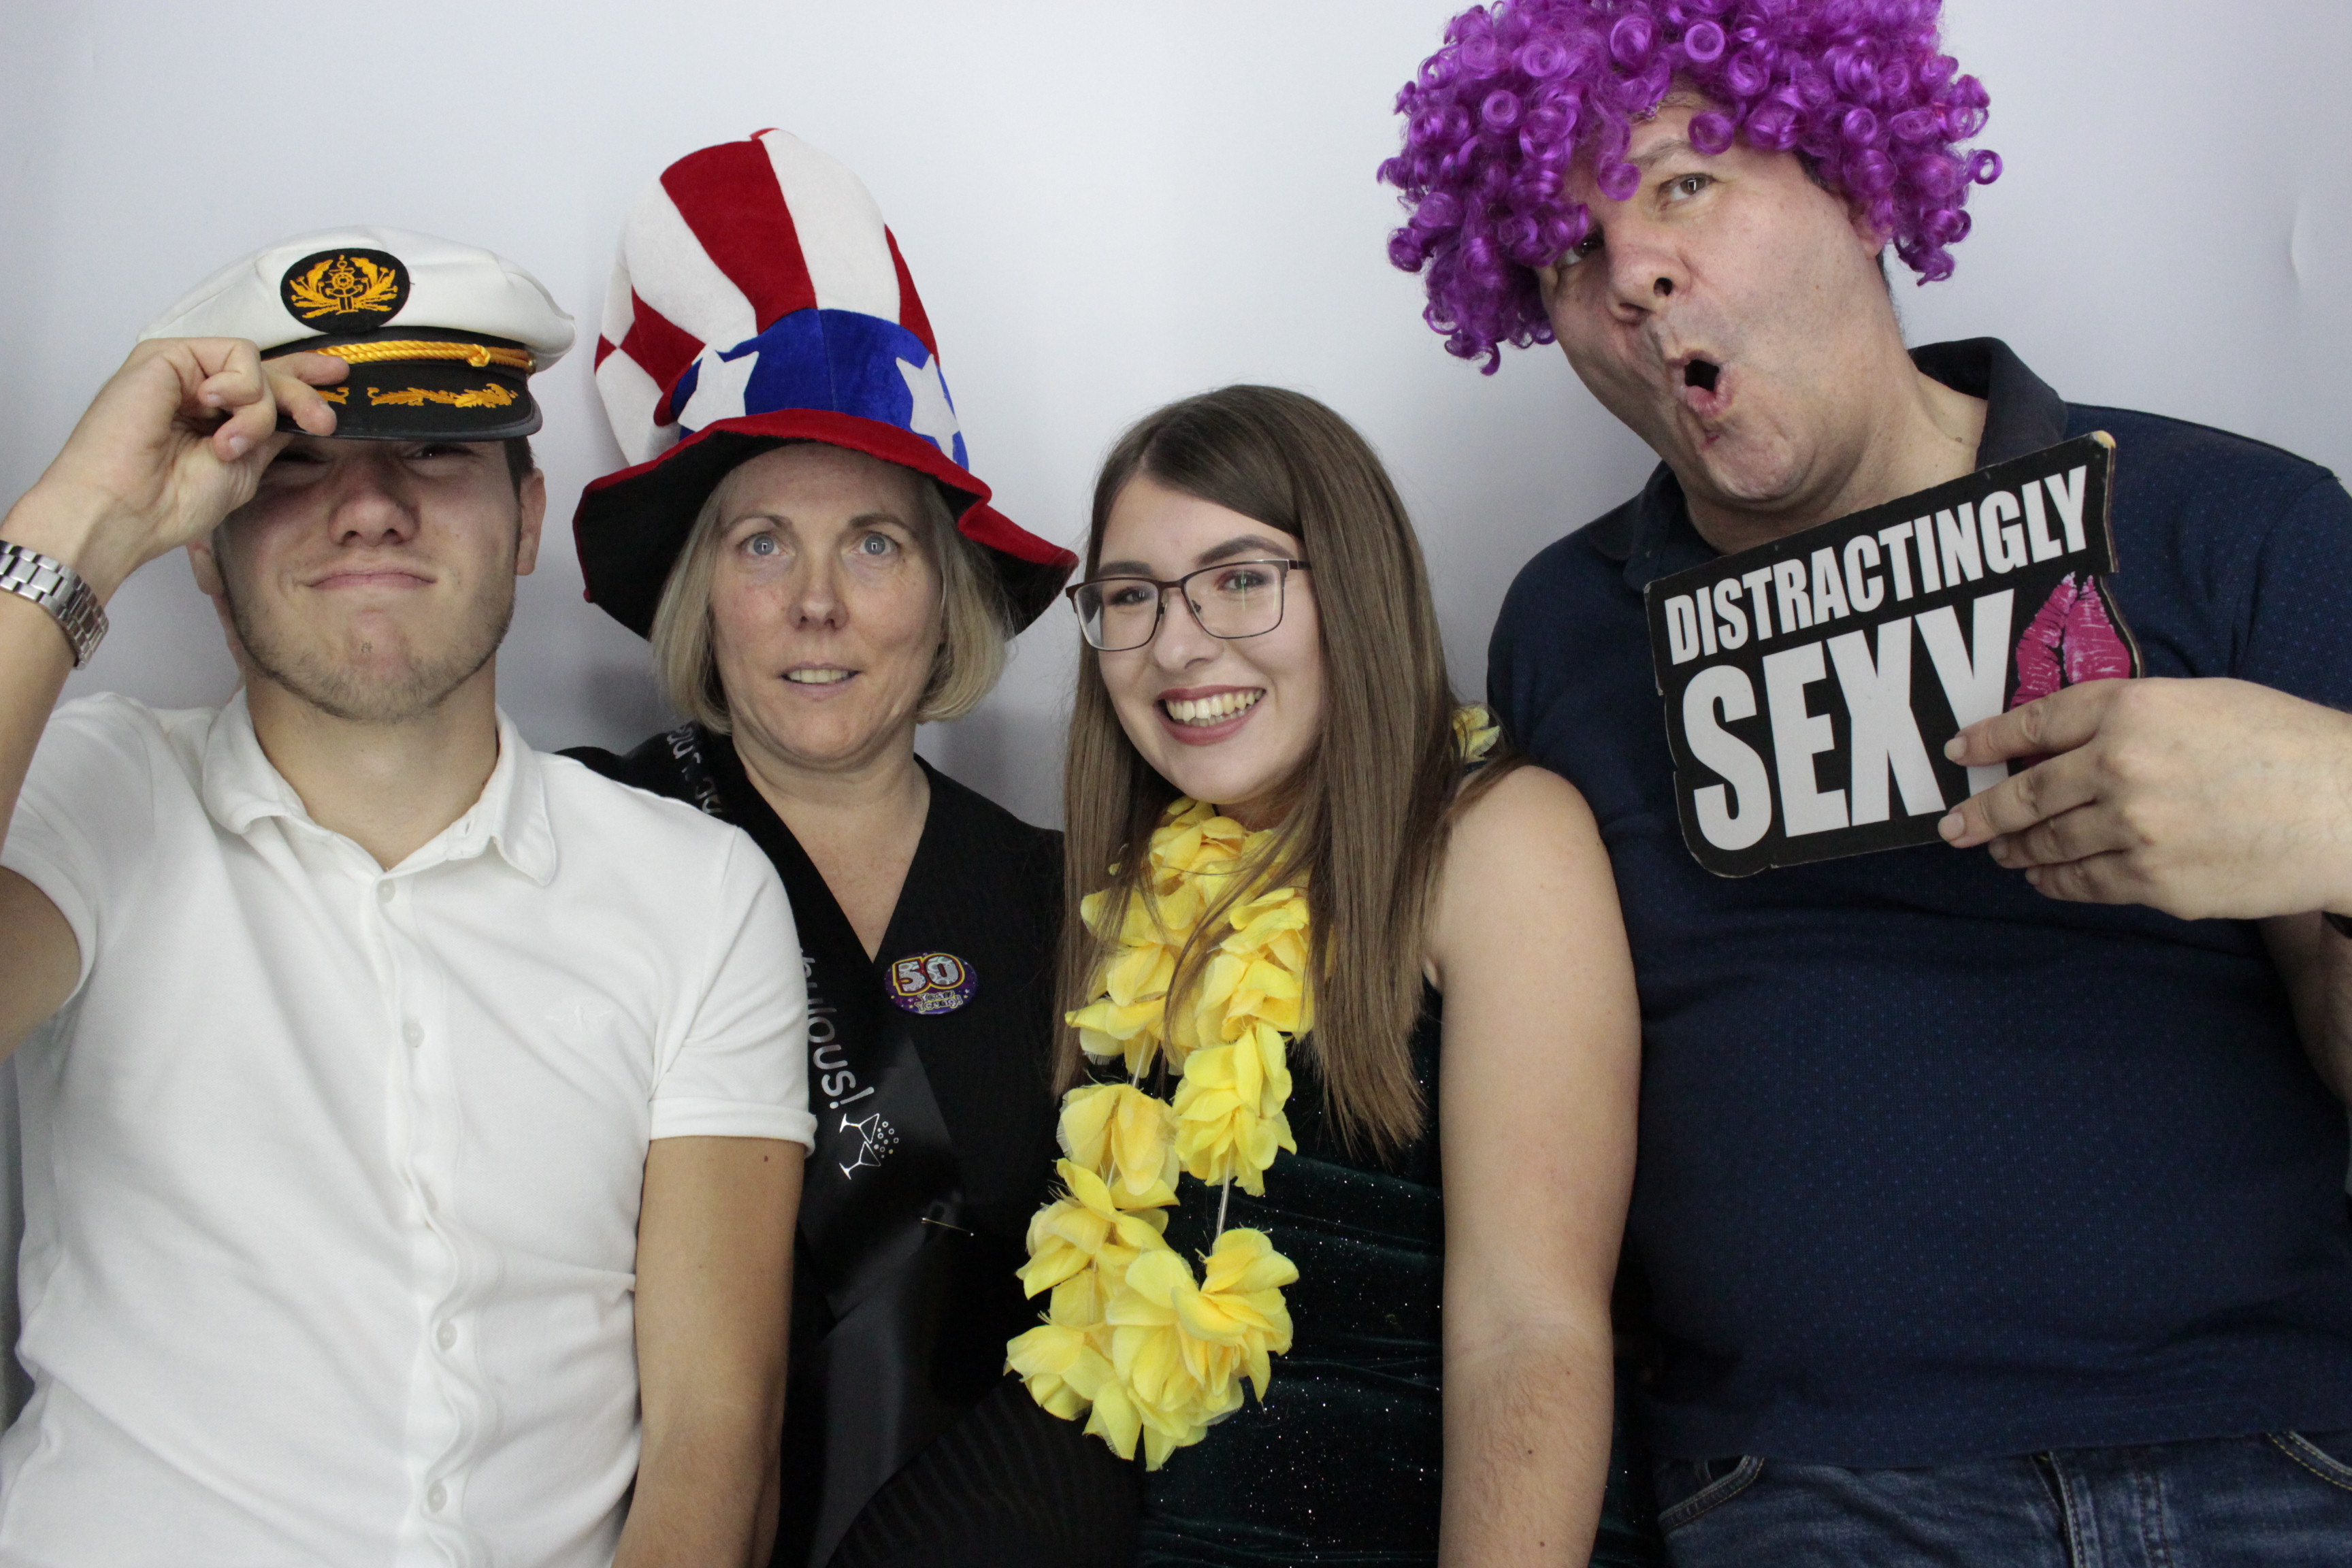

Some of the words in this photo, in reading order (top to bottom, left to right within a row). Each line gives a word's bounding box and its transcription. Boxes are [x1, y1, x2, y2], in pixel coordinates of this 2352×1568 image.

[1665, 465, 2087, 665] DISTRACTINGLY
[1682, 588, 2015, 851] SEXY
[894, 954, 964, 994] 50
